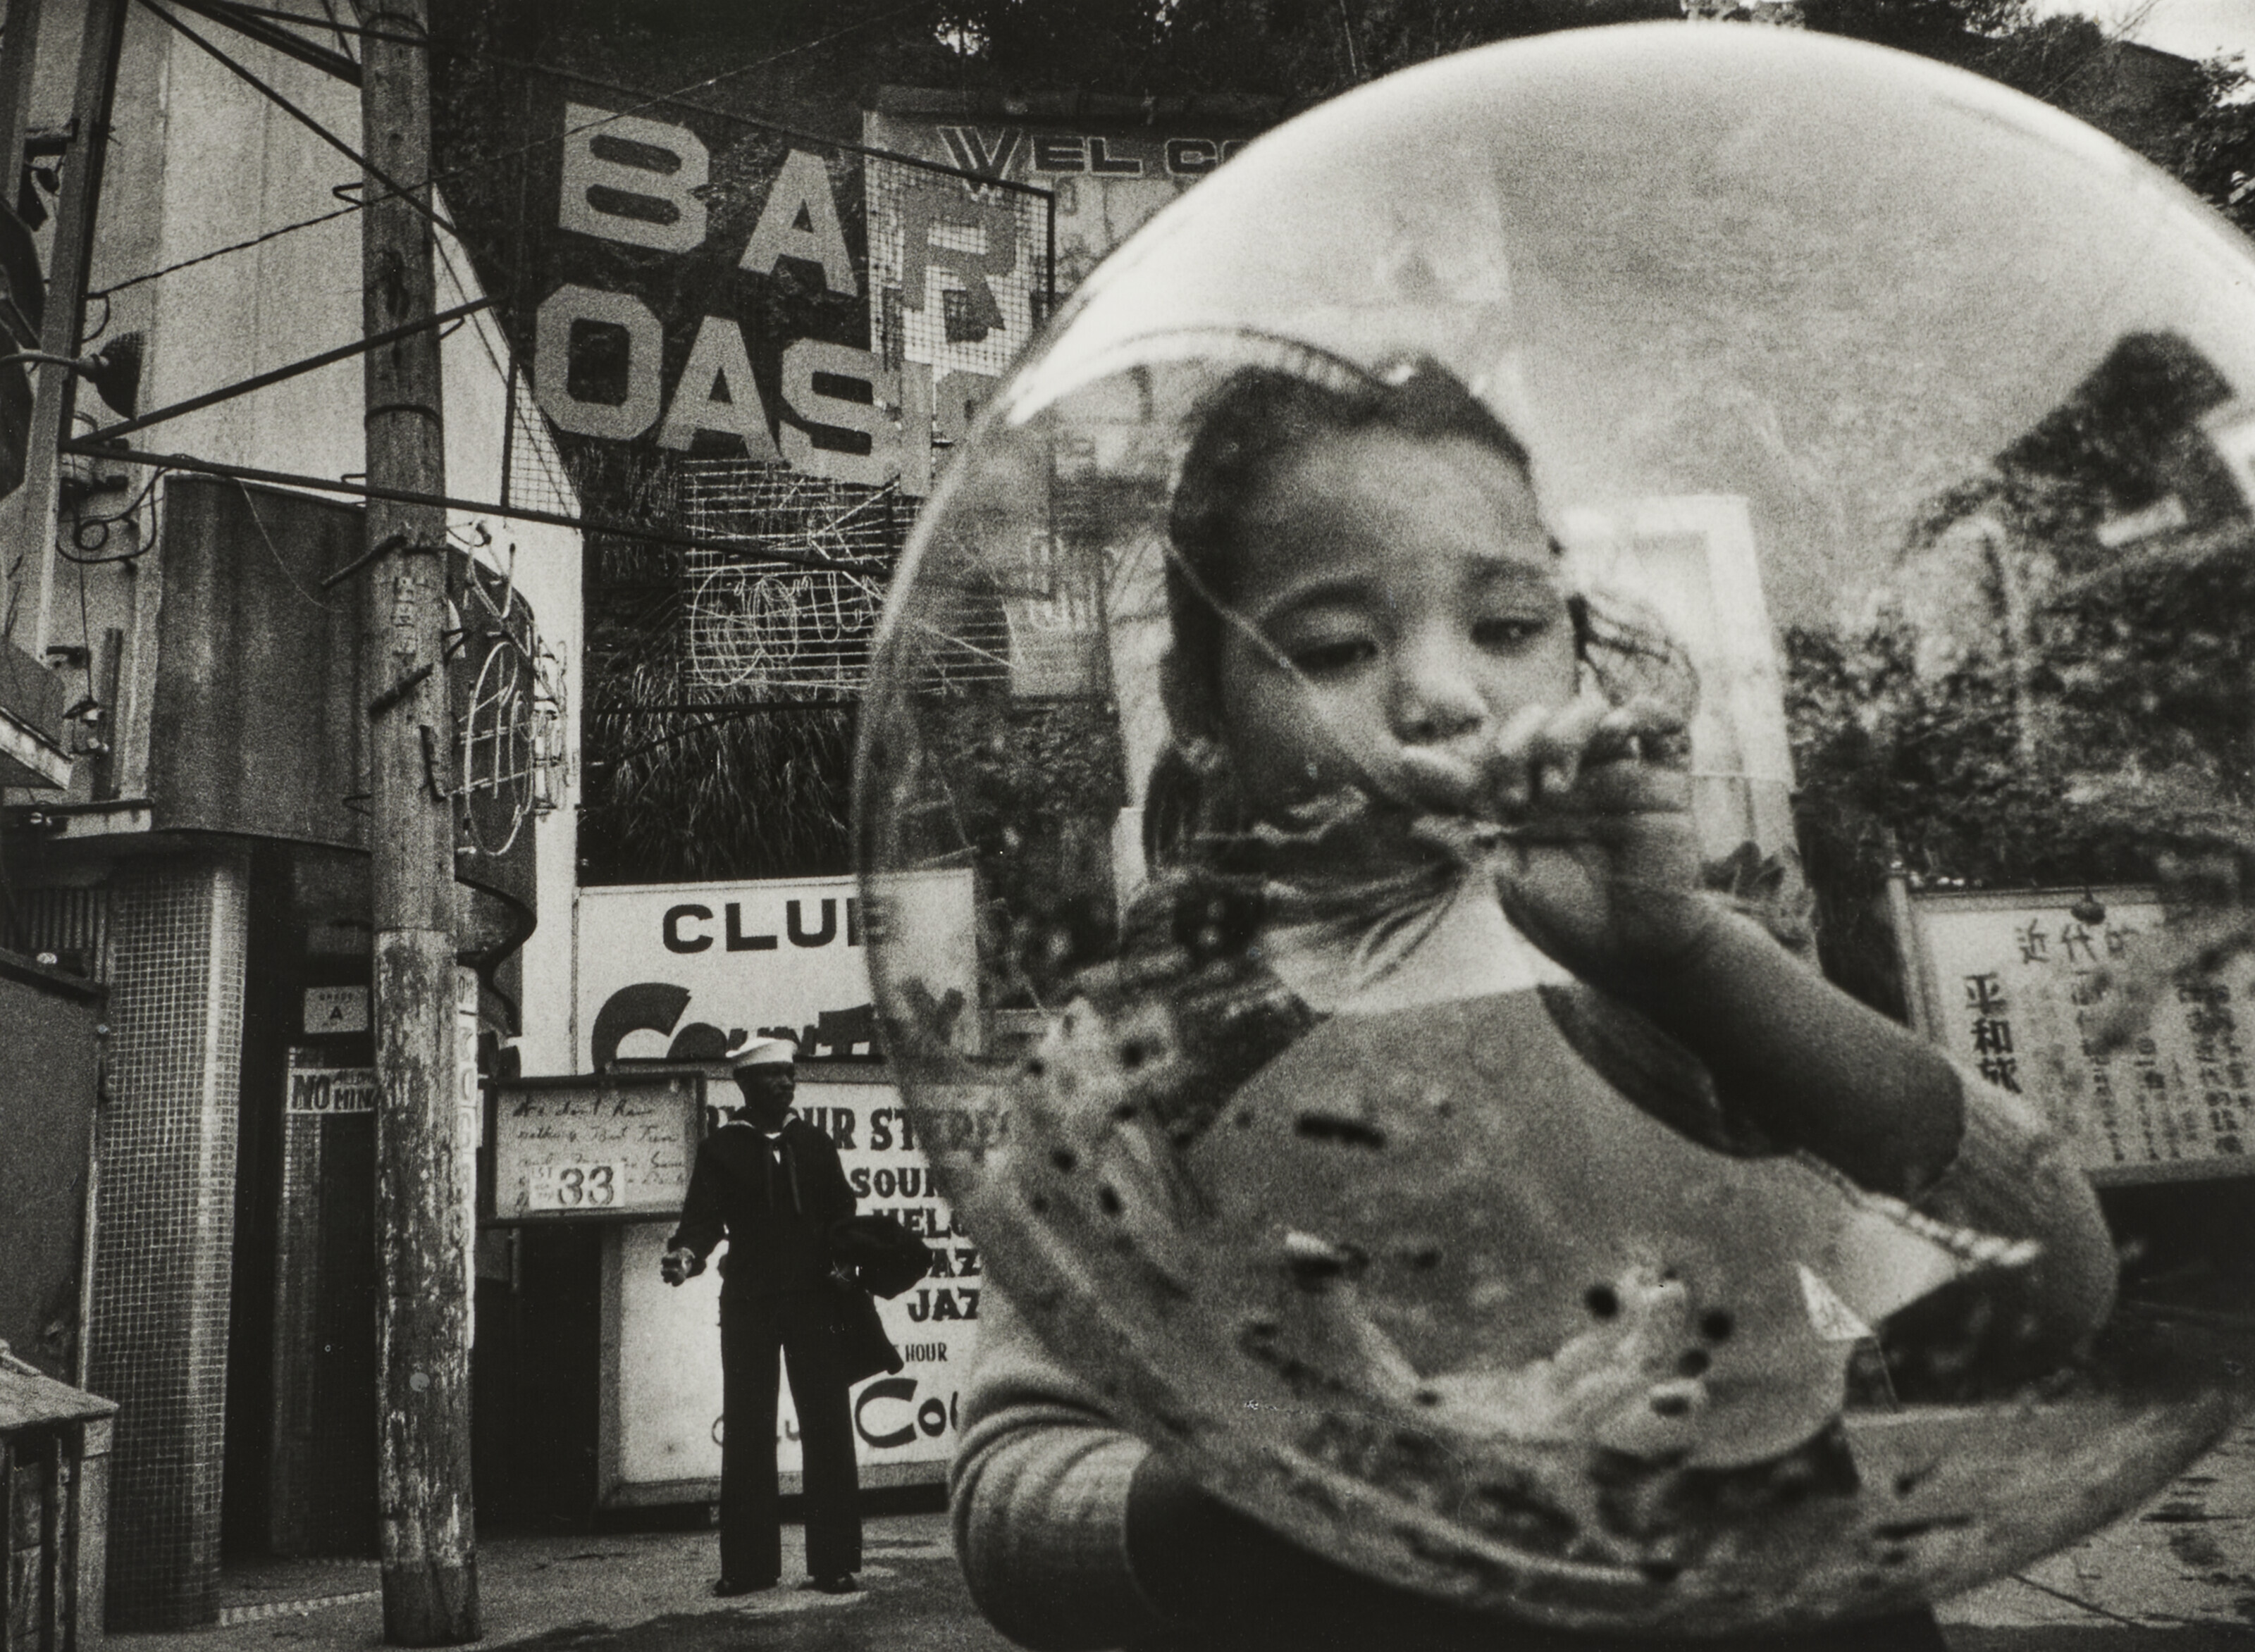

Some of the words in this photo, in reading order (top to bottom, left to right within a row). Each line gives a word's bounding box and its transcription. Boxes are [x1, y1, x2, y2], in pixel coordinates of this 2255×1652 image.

[559, 101, 1018, 338] BAR
[329, 1005, 343, 1020] A
[291, 1074, 330, 1110] NO
[335, 1088, 381, 1110] MIN
[557, 1167, 615, 1207] 33
[906, 1288, 980, 1323] JAZ
[905, 1342, 949, 1362] HOUR
